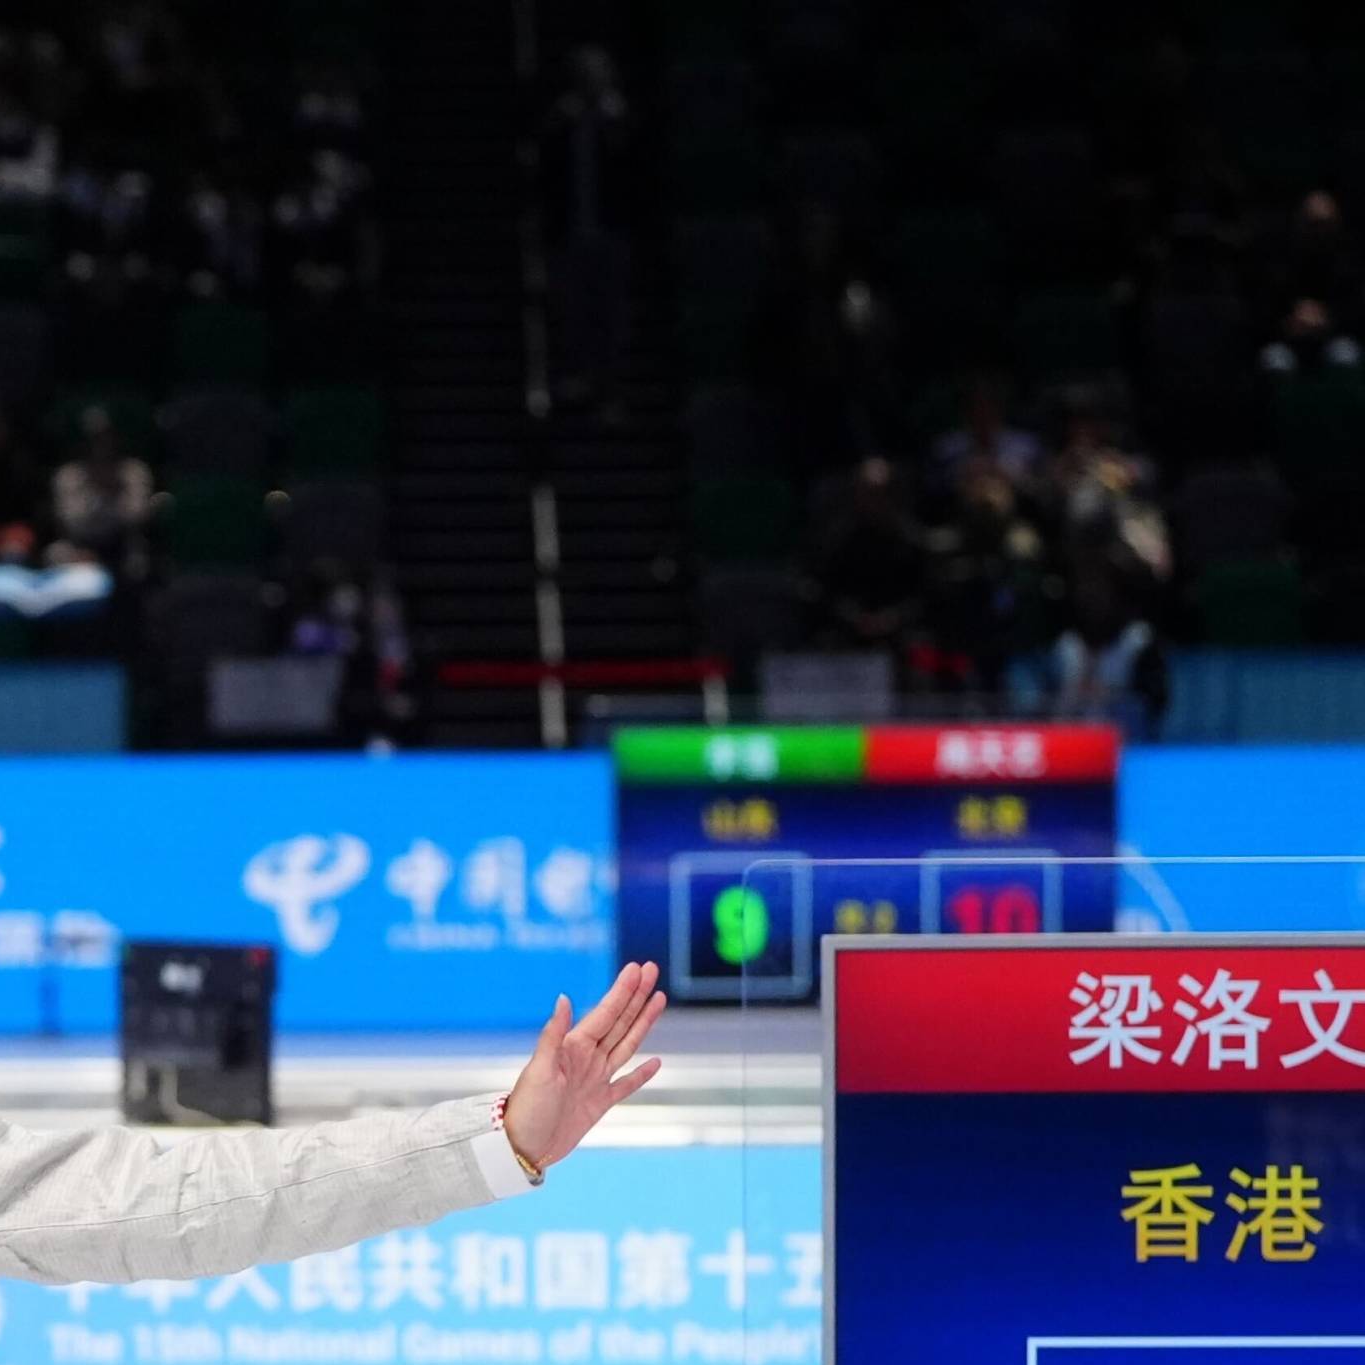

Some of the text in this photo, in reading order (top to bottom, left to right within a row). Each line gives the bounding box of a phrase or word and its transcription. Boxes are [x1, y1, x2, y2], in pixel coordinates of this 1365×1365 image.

[712, 884, 769, 964] 9
[946, 884, 1042, 933] 10
[1069, 970, 1365, 1070] 梁洛文
[1120, 1163, 1324, 1263] 香港
[50, 1323, 123, 1365] The
[227, 1322, 398, 1365] National
[401, 1322, 543, 1365] Games
[547, 1321, 594, 1365] of
[597, 1322, 668, 1365] the
